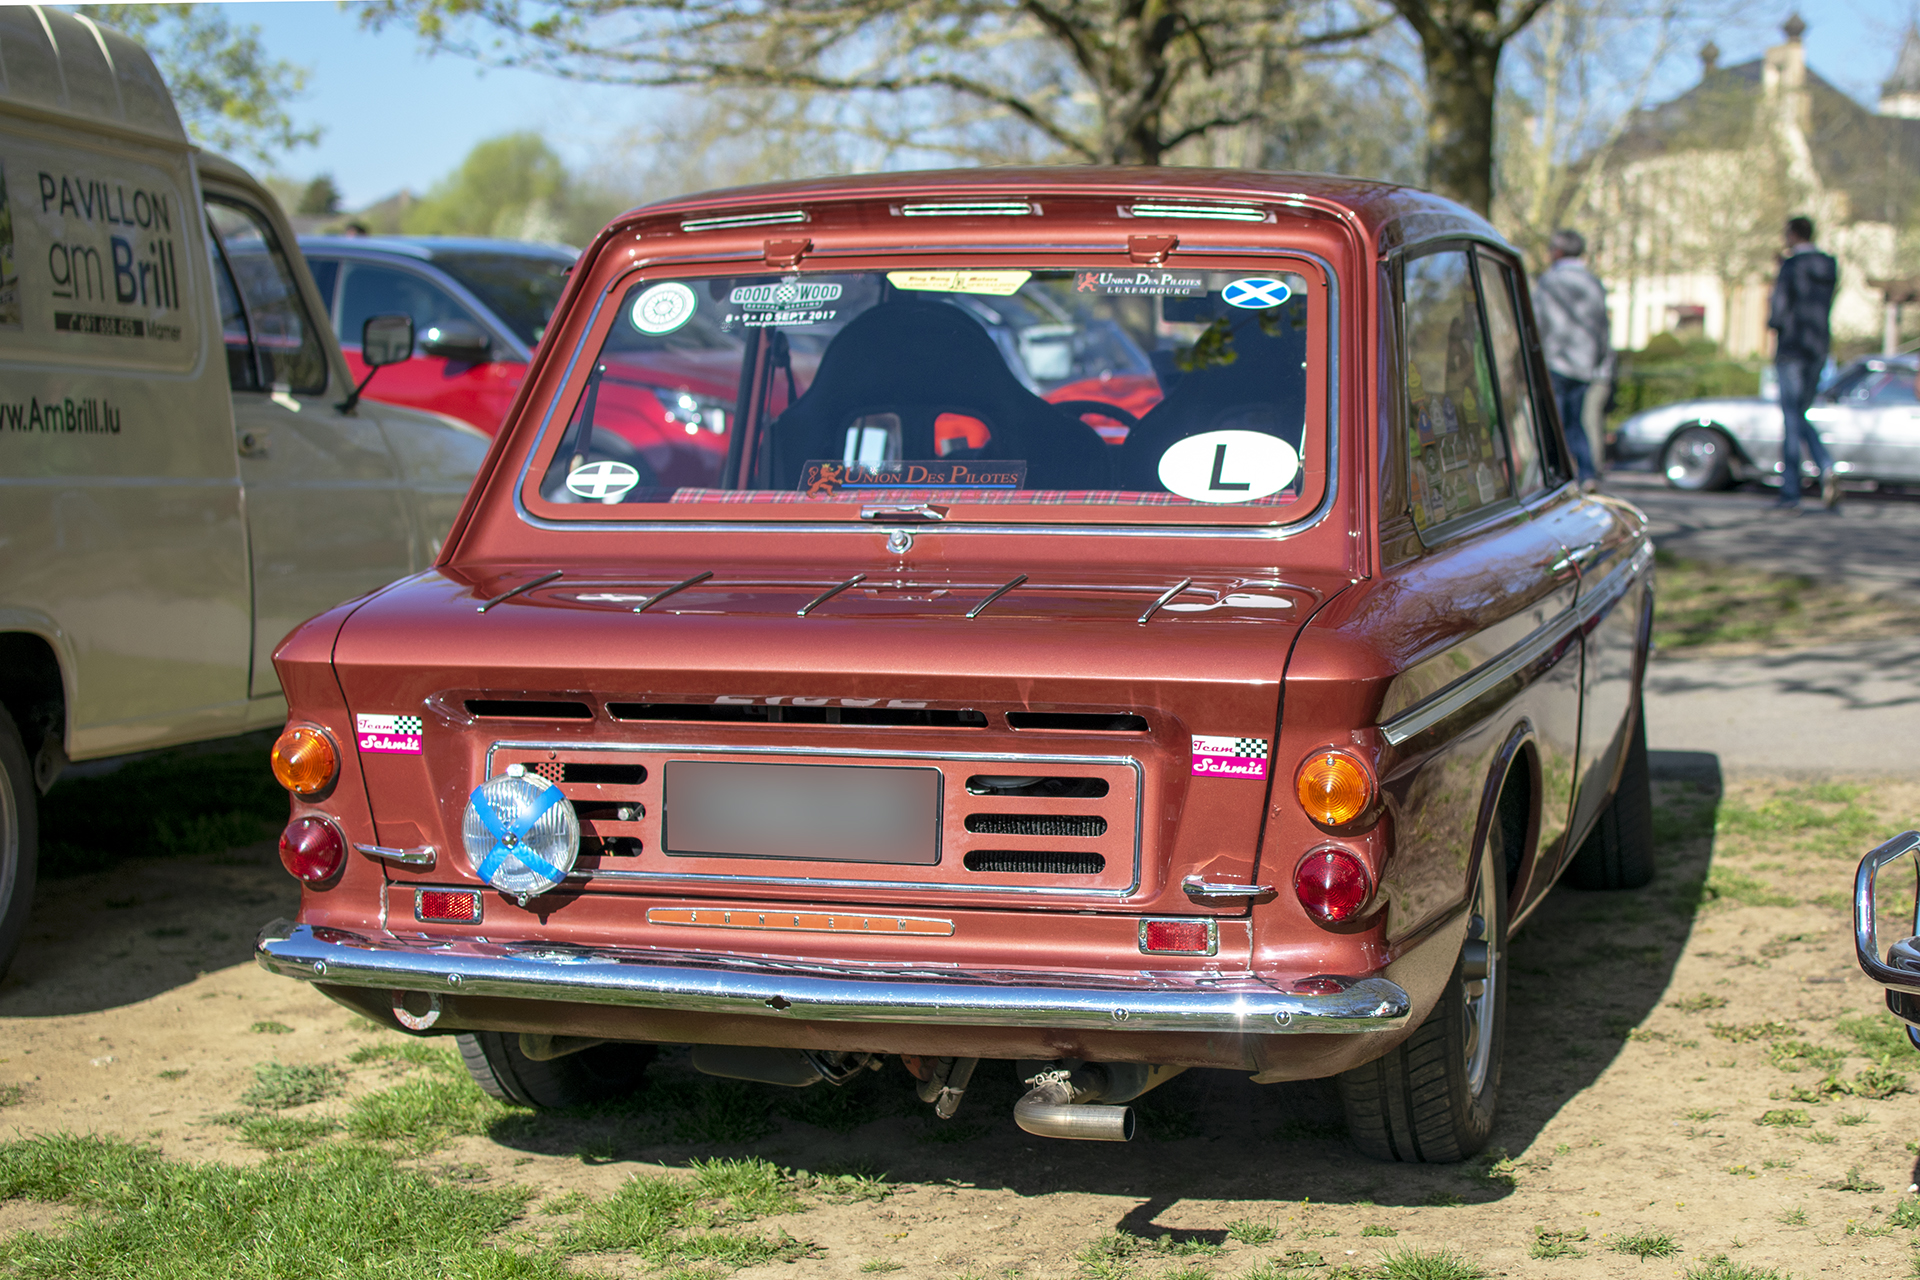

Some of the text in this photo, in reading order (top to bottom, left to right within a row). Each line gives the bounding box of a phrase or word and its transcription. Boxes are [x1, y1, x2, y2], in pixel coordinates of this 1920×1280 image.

[38, 171, 171, 233] PAVILLON
[49, 235, 180, 311] am Brill
[1099, 272, 1134, 285] UNION
[1160, 273, 1202, 287] PILOTES
[734, 284, 839, 302] GOOD WOOD
[1107, 286, 1191, 296] LUXEMBOURG
[774, 311, 807, 321] SEPT
[808, 310, 837, 320] 2017
[0, 395, 121, 434] w.AmBrill.lu
[844, 465, 1018, 484] UNION DES PILOTES
[1208, 443, 1251, 491] L
[358, 719, 393, 730] Team
[360, 735, 420, 751] Schmit
[1192, 740, 1235, 753] Team
[1193, 758, 1263, 775] Schmit
[690, 911, 907, 931] SUNBEAM
